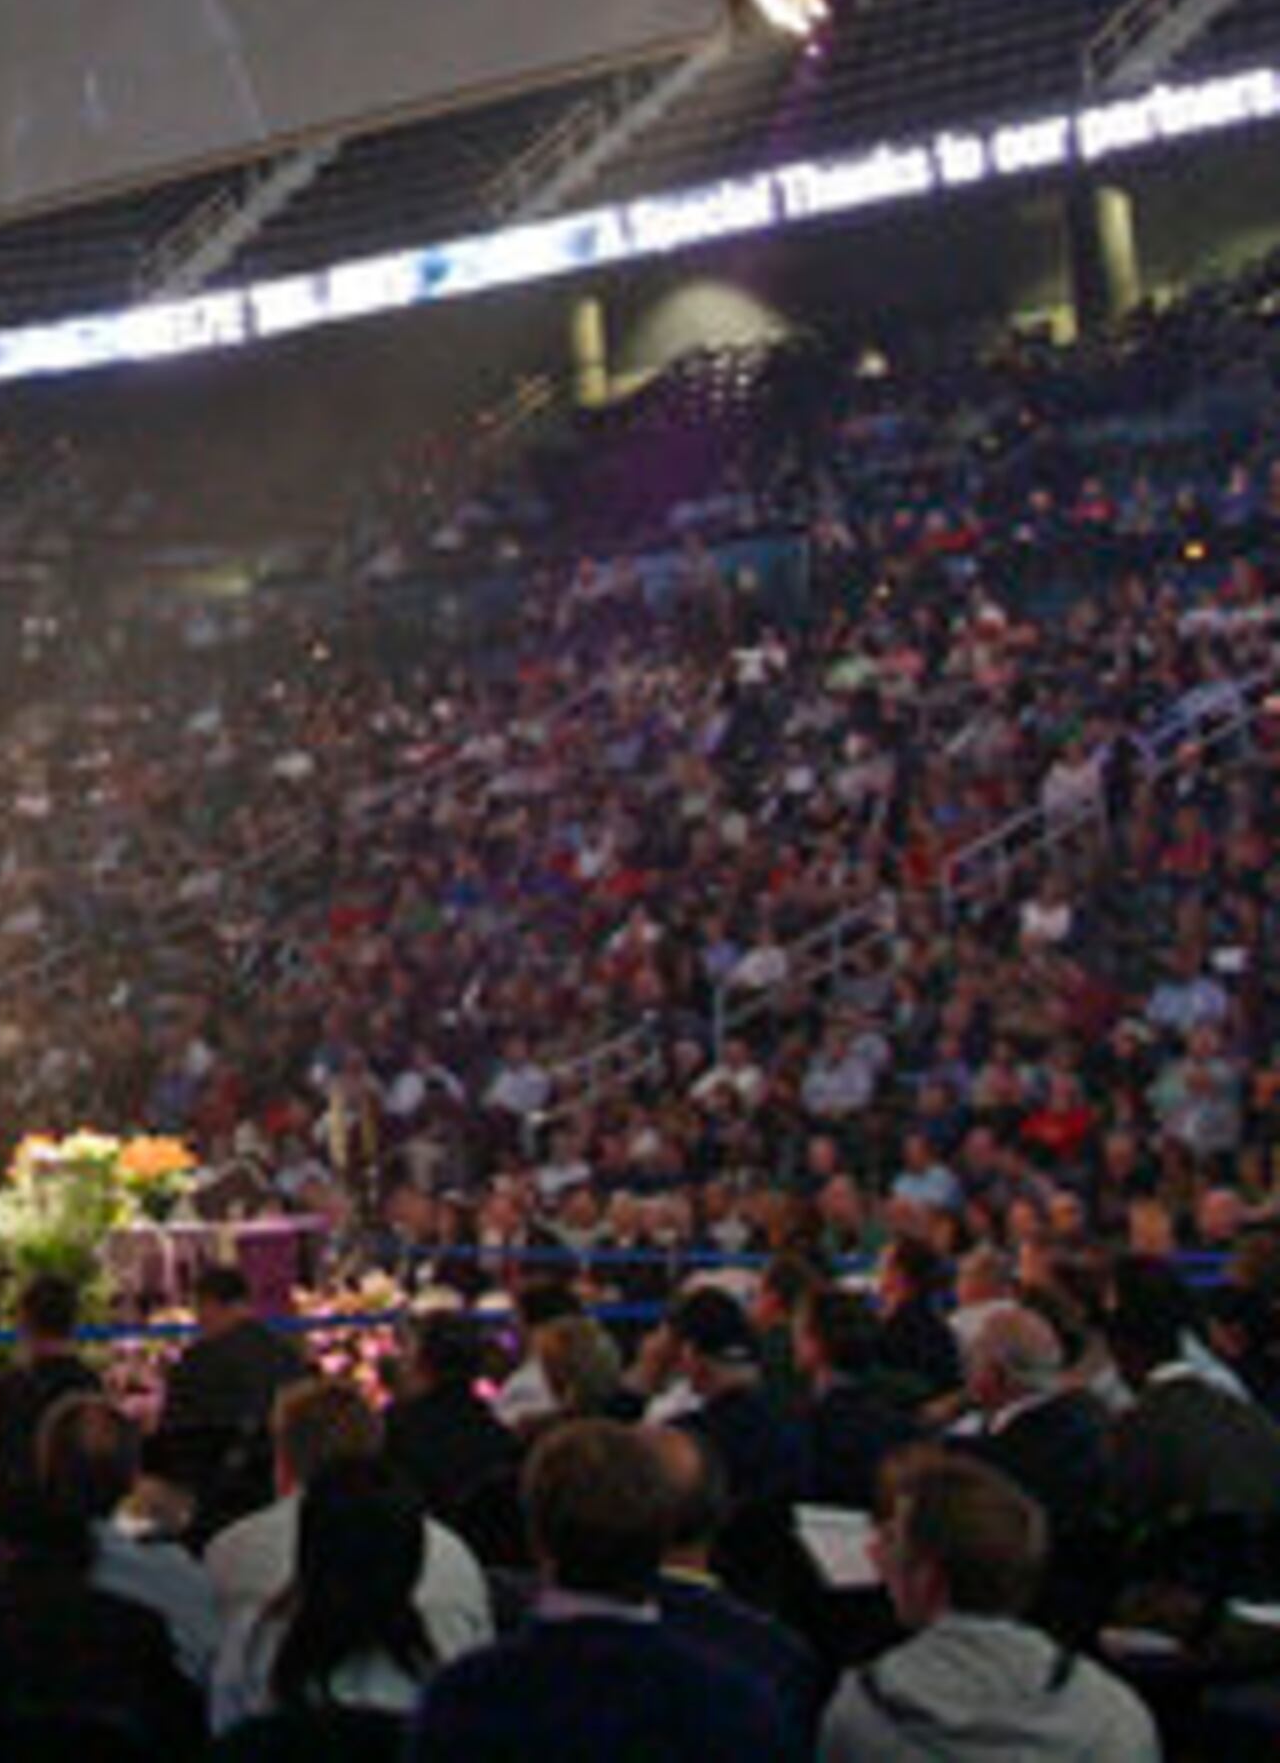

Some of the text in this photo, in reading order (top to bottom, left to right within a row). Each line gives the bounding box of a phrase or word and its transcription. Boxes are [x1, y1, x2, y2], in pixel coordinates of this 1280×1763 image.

[632, 172, 774, 252] Special
[778, 146, 931, 218] Thanks
[936, 132, 985, 184] to
[994, 116, 1069, 172] our
[1078, 67, 1278, 161] partners
